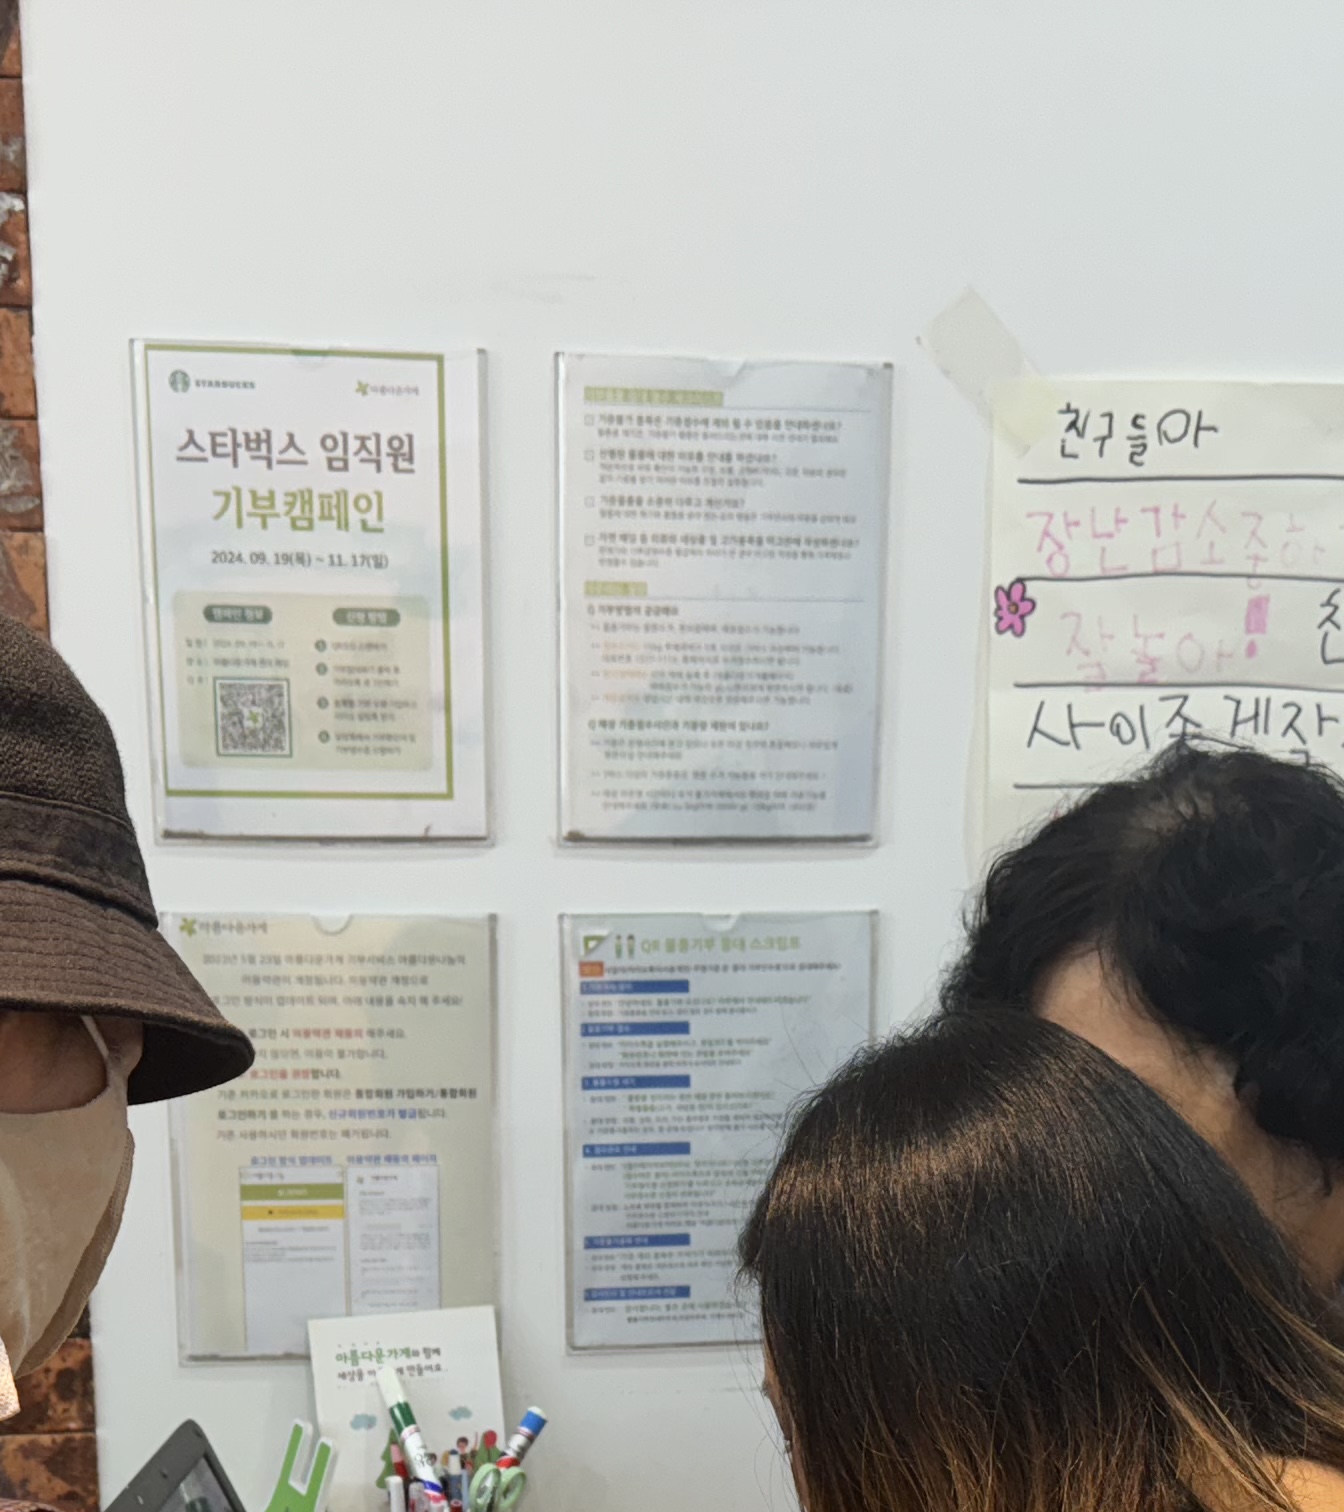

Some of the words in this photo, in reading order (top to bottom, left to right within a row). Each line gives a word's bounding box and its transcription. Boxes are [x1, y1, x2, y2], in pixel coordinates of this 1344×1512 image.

[175, 426, 309, 471] 스타벅스
[319, 430, 416, 475] 임직원
[1057, 403, 1219, 467] 친구들아
[211, 485, 385, 534] 기부캠페인
[211, 550, 247, 566] 2024.
[249, 551, 270, 566] 09.
[274, 552, 312, 568] 19(목)
[327, 553, 347, 568] 11.
